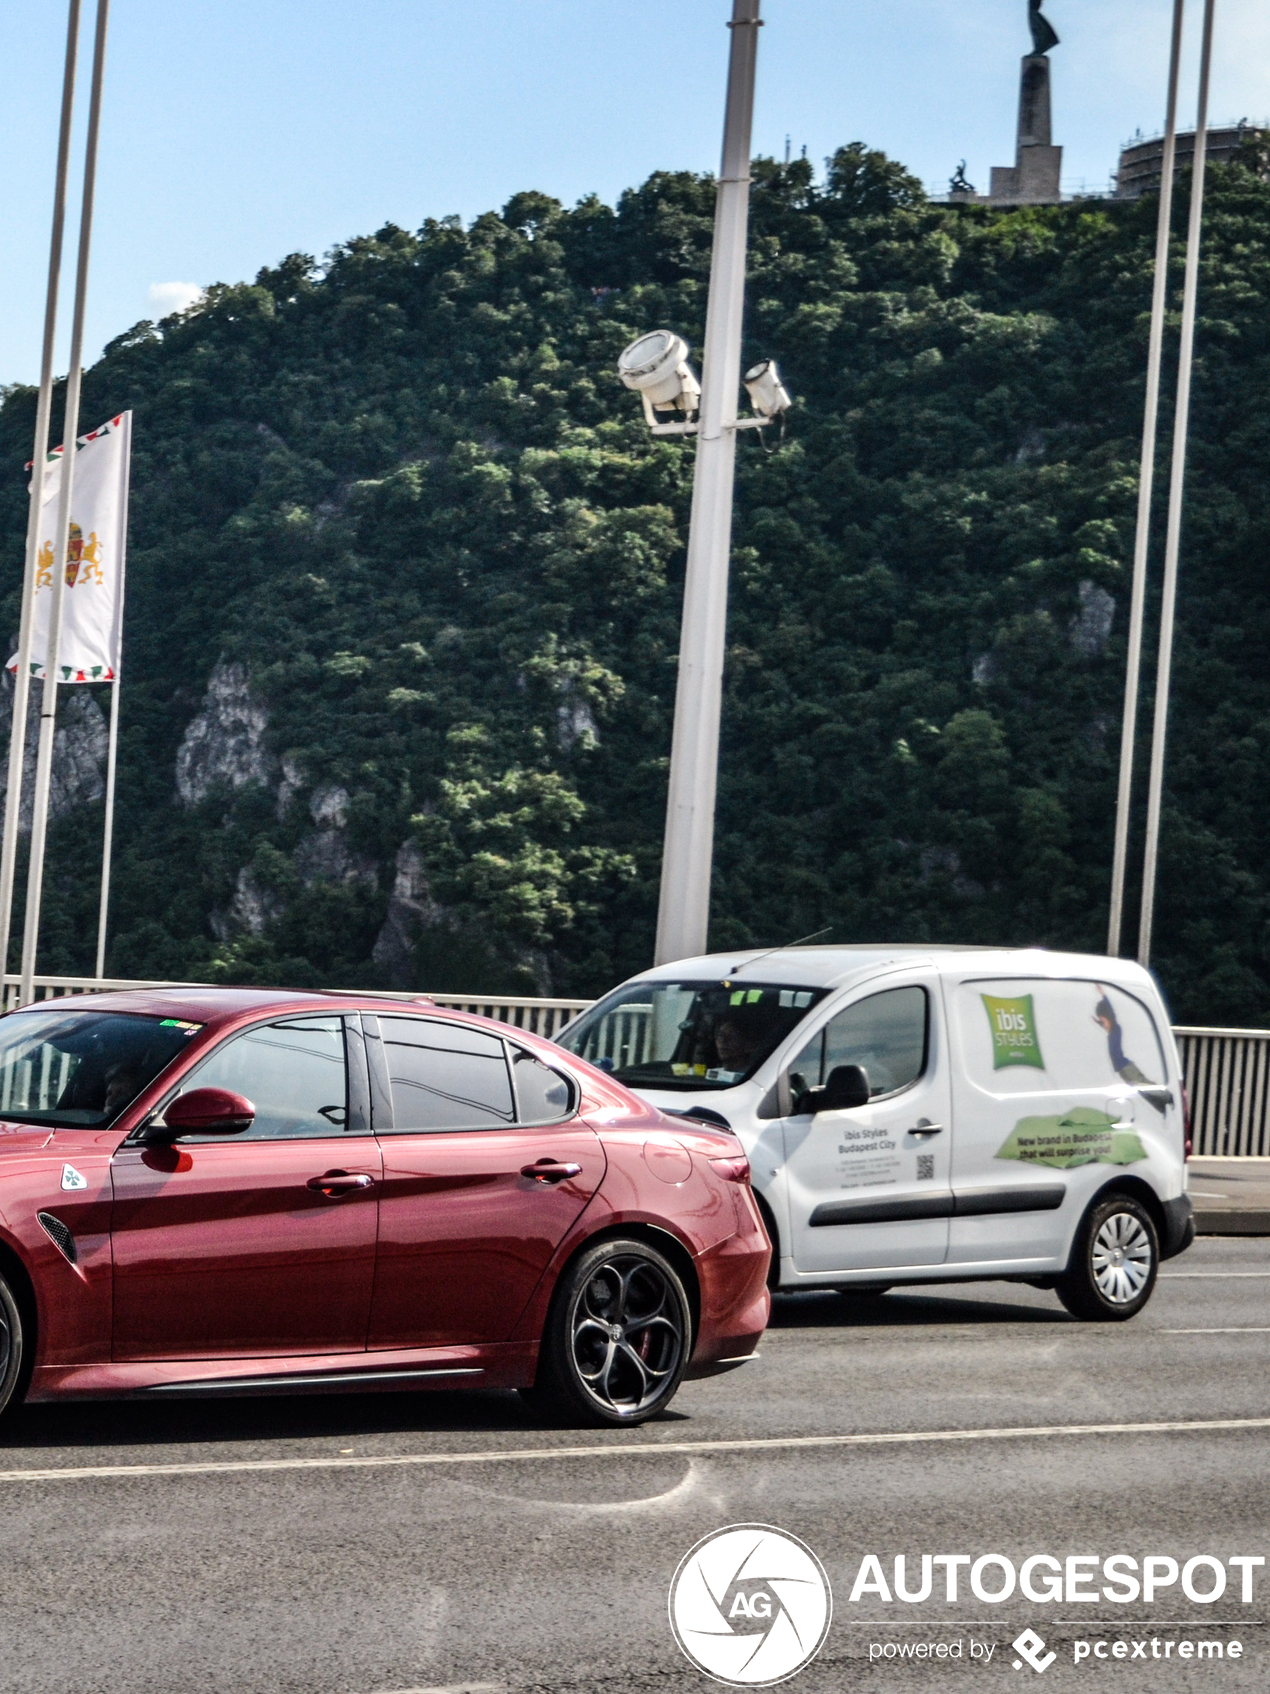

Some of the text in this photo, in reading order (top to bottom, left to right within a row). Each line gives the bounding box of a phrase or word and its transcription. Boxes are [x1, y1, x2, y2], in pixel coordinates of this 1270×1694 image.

[996, 1008, 1026, 1030] ibis
[844, 1129, 888, 1140] ibis Styles
[1018, 1132, 1112, 1146] New brand in Budapest
[838, 1140, 896, 1154] Budapest City
[1020, 1149, 1036, 1158] that
[1039, 1148, 1055, 1157] will
[1056, 1147, 1090, 1158] surprise
